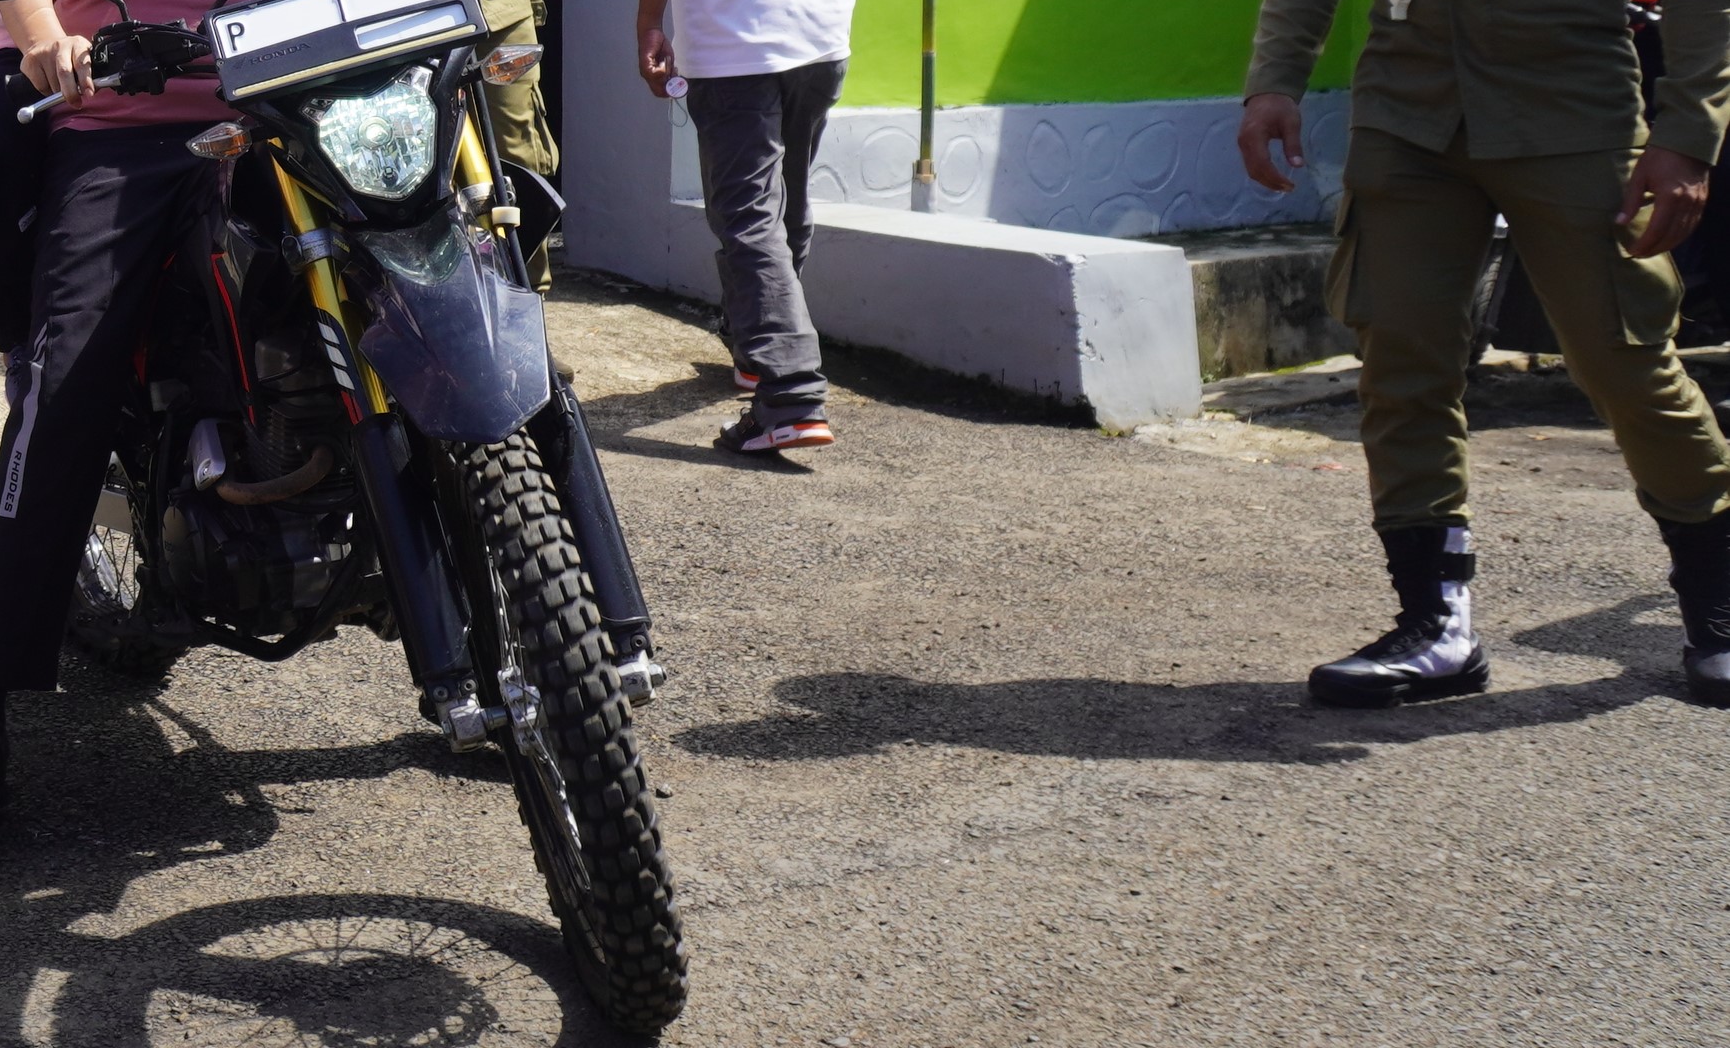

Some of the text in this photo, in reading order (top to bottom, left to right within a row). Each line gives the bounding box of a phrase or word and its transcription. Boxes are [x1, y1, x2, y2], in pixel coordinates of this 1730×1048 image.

[226, 21, 245, 51] P
[249, 41, 312, 66] HONDA
[3, 450, 23, 513] RHODES
